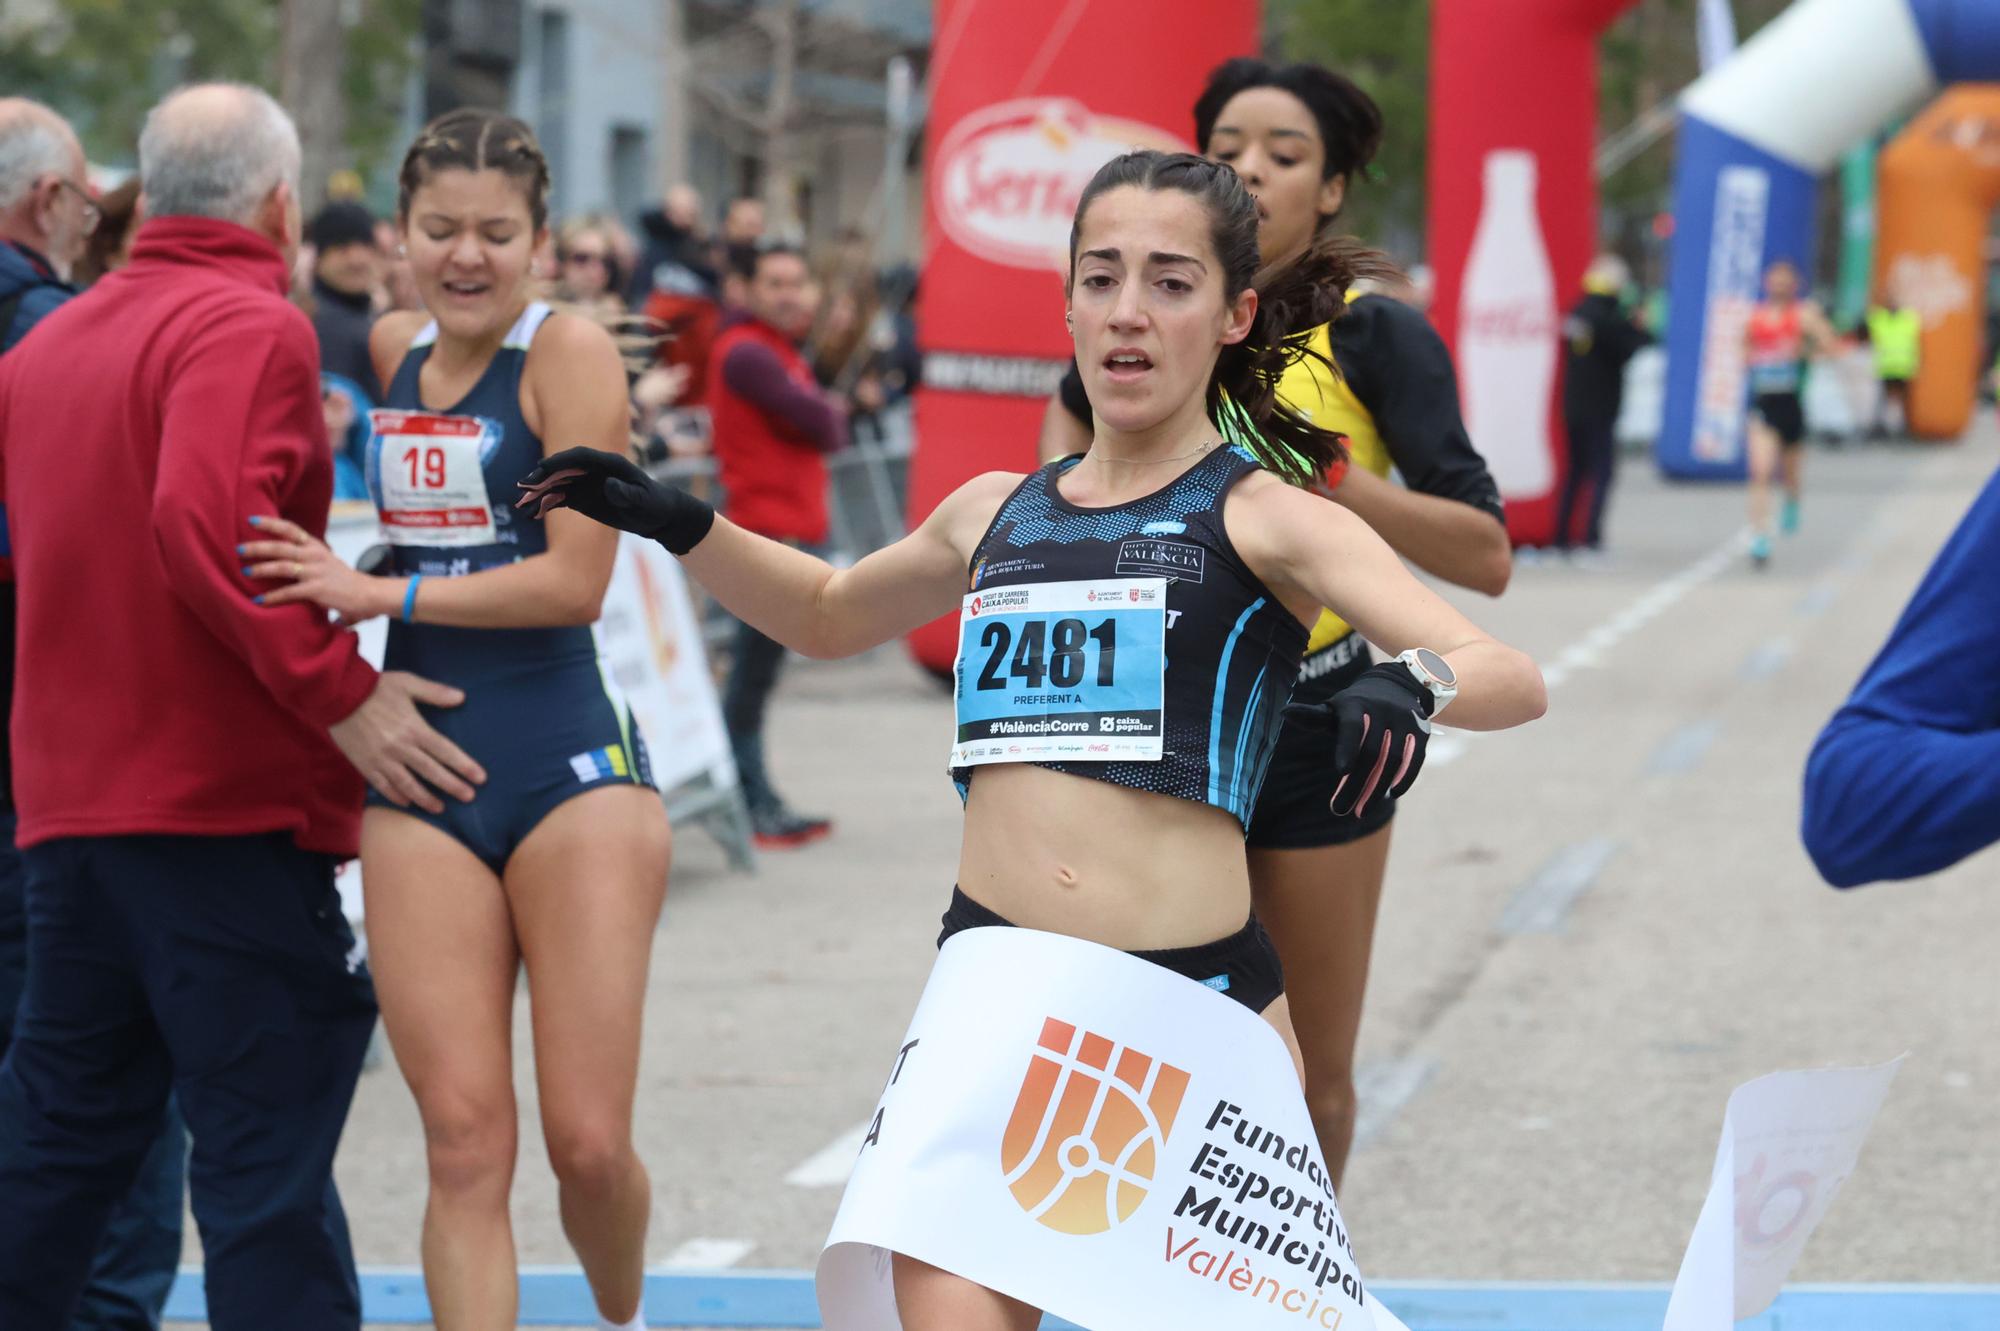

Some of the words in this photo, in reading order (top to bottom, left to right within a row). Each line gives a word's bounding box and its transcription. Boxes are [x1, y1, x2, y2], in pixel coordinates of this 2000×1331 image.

[402, 447, 446, 489] 19
[982, 599, 1001, 609] CAIXA
[1002, 597, 1029, 606] POPULAR
[977, 618, 1116, 691] 2481
[1013, 694, 1072, 705] PREFERENT
[1074, 694, 1082, 704] A
[989, 719, 1090, 734] #ValènciaCorre
[1115, 717, 1140, 725] caixa
[1115, 723, 1154, 732] popular
[1205, 1099, 1337, 1208] Fundac
[1173, 1185, 1363, 1307] Municipal
[1165, 1226, 1343, 1331] València
